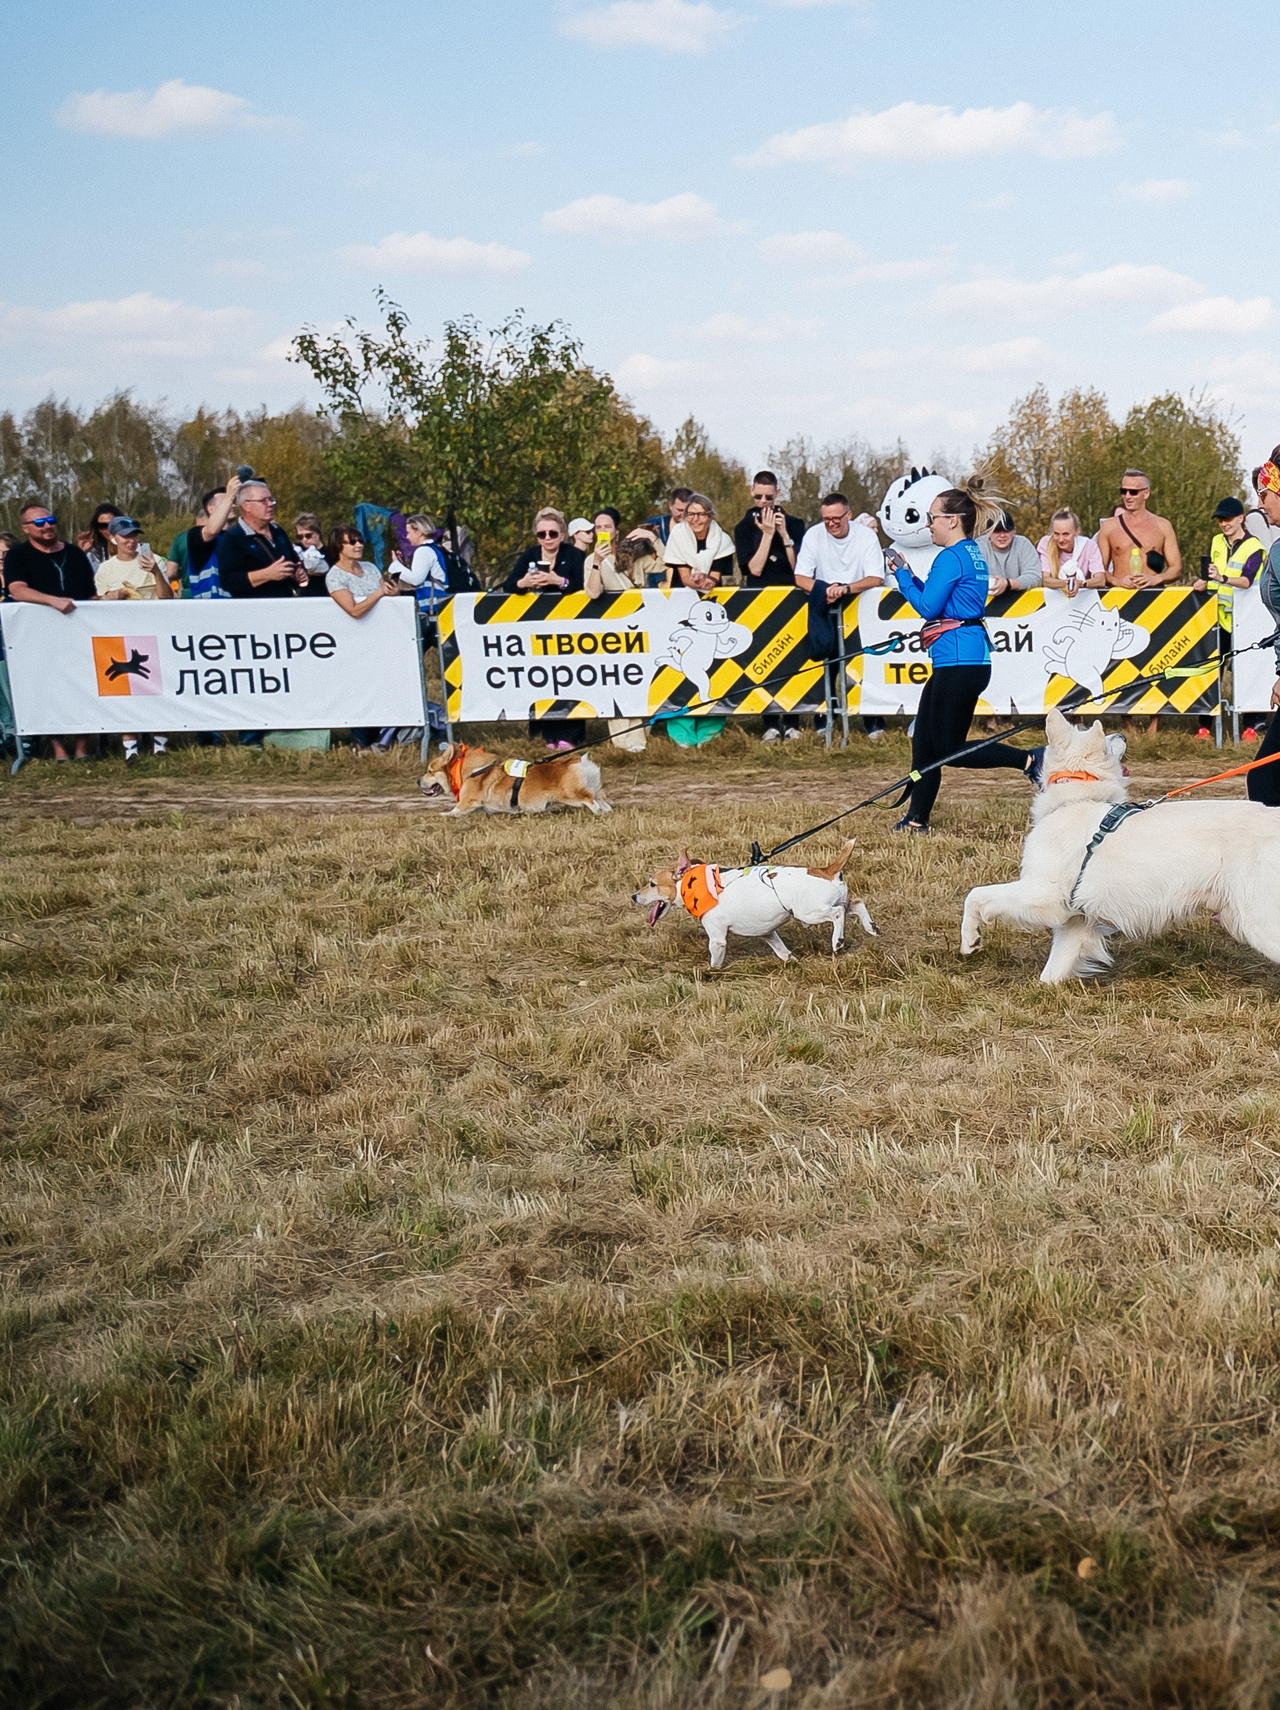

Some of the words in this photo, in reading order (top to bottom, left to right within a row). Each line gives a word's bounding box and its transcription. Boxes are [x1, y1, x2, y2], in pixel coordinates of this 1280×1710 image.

[171, 632, 337, 661] четыре
[482, 634, 526, 658] на
[535, 624, 645, 656] твоей
[752, 633, 795, 676] билайн
[1148, 635, 1192, 675] билайн
[175, 667, 291, 696] лапы
[486, 663, 644, 696] стороне
